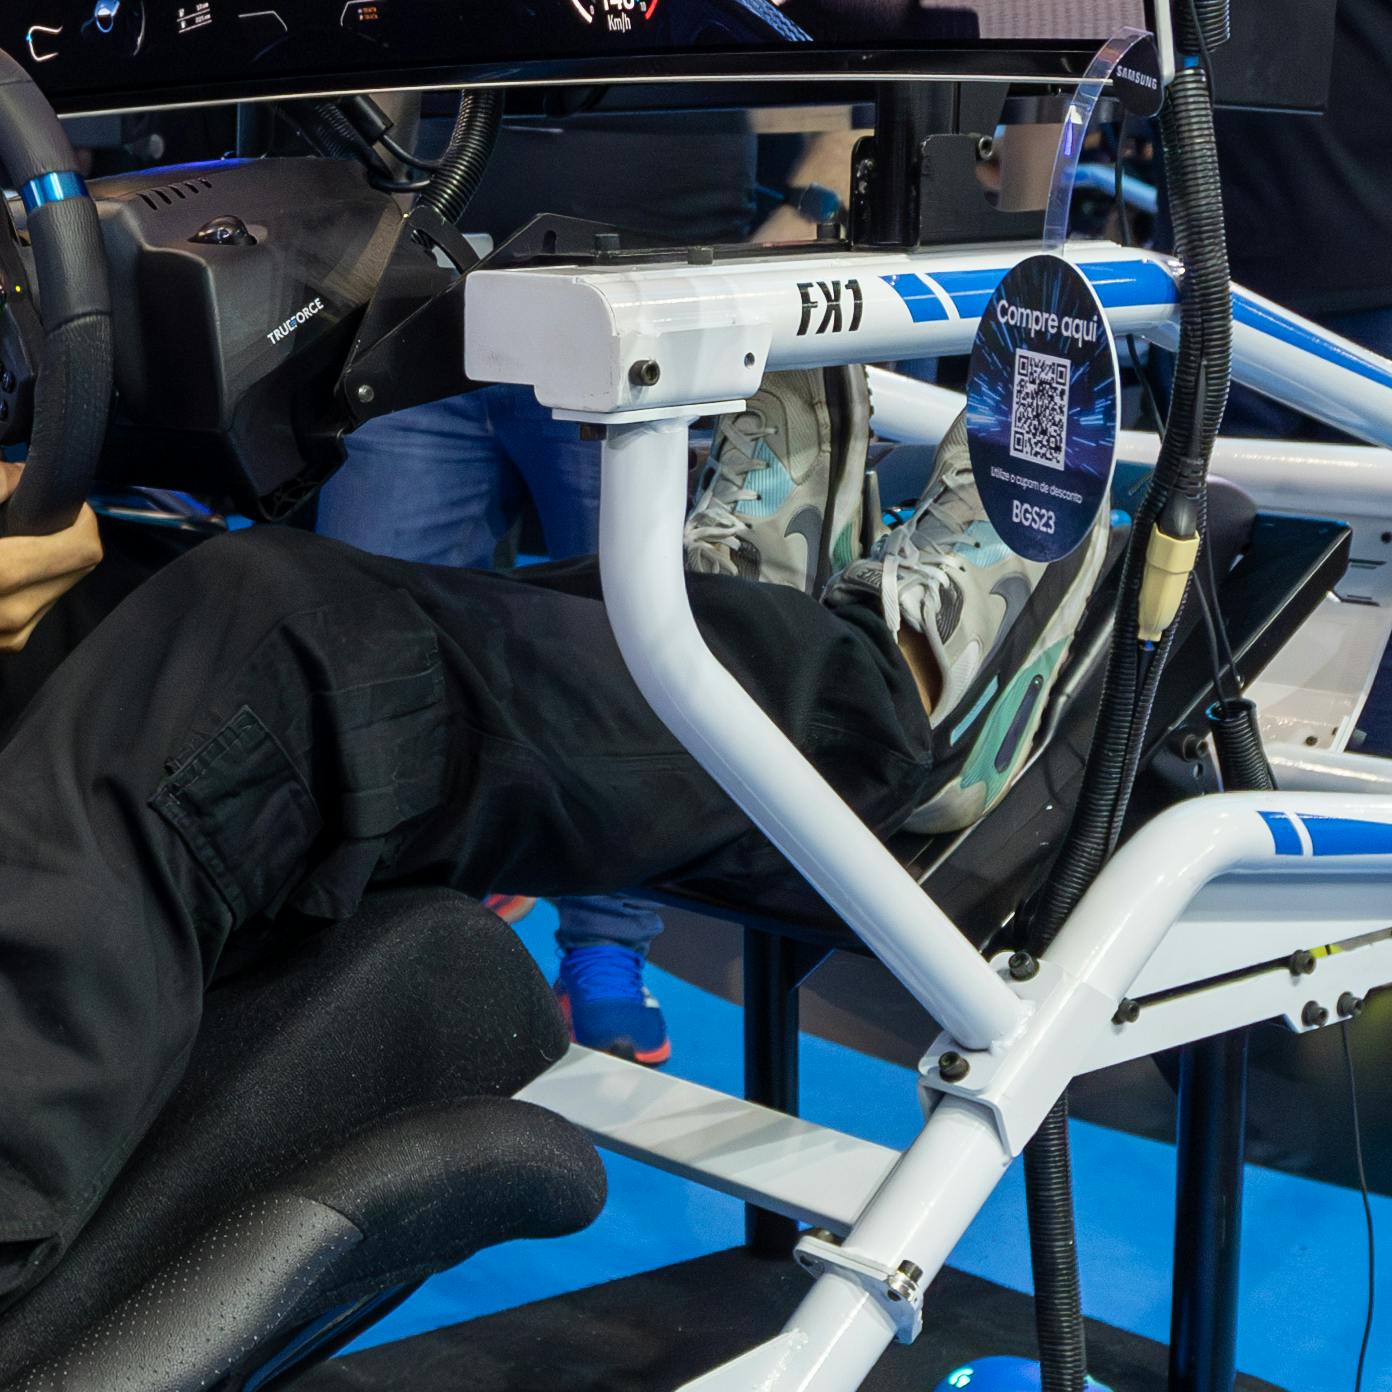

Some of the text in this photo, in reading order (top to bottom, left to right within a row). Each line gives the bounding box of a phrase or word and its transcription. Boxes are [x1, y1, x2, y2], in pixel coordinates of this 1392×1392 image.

[607, 11, 632, 33] Km/h
[1116, 65, 1157, 91] SAMSUNG
[267, 297, 325, 345] TRUEFORCE
[796, 279, 863, 337] FX1
[996, 298, 1098, 349] Compre aqui
[1039, 480, 1050, 494] de
[1049, 483, 1083, 505] desconto
[1012, 499, 1056, 535] BGS23
